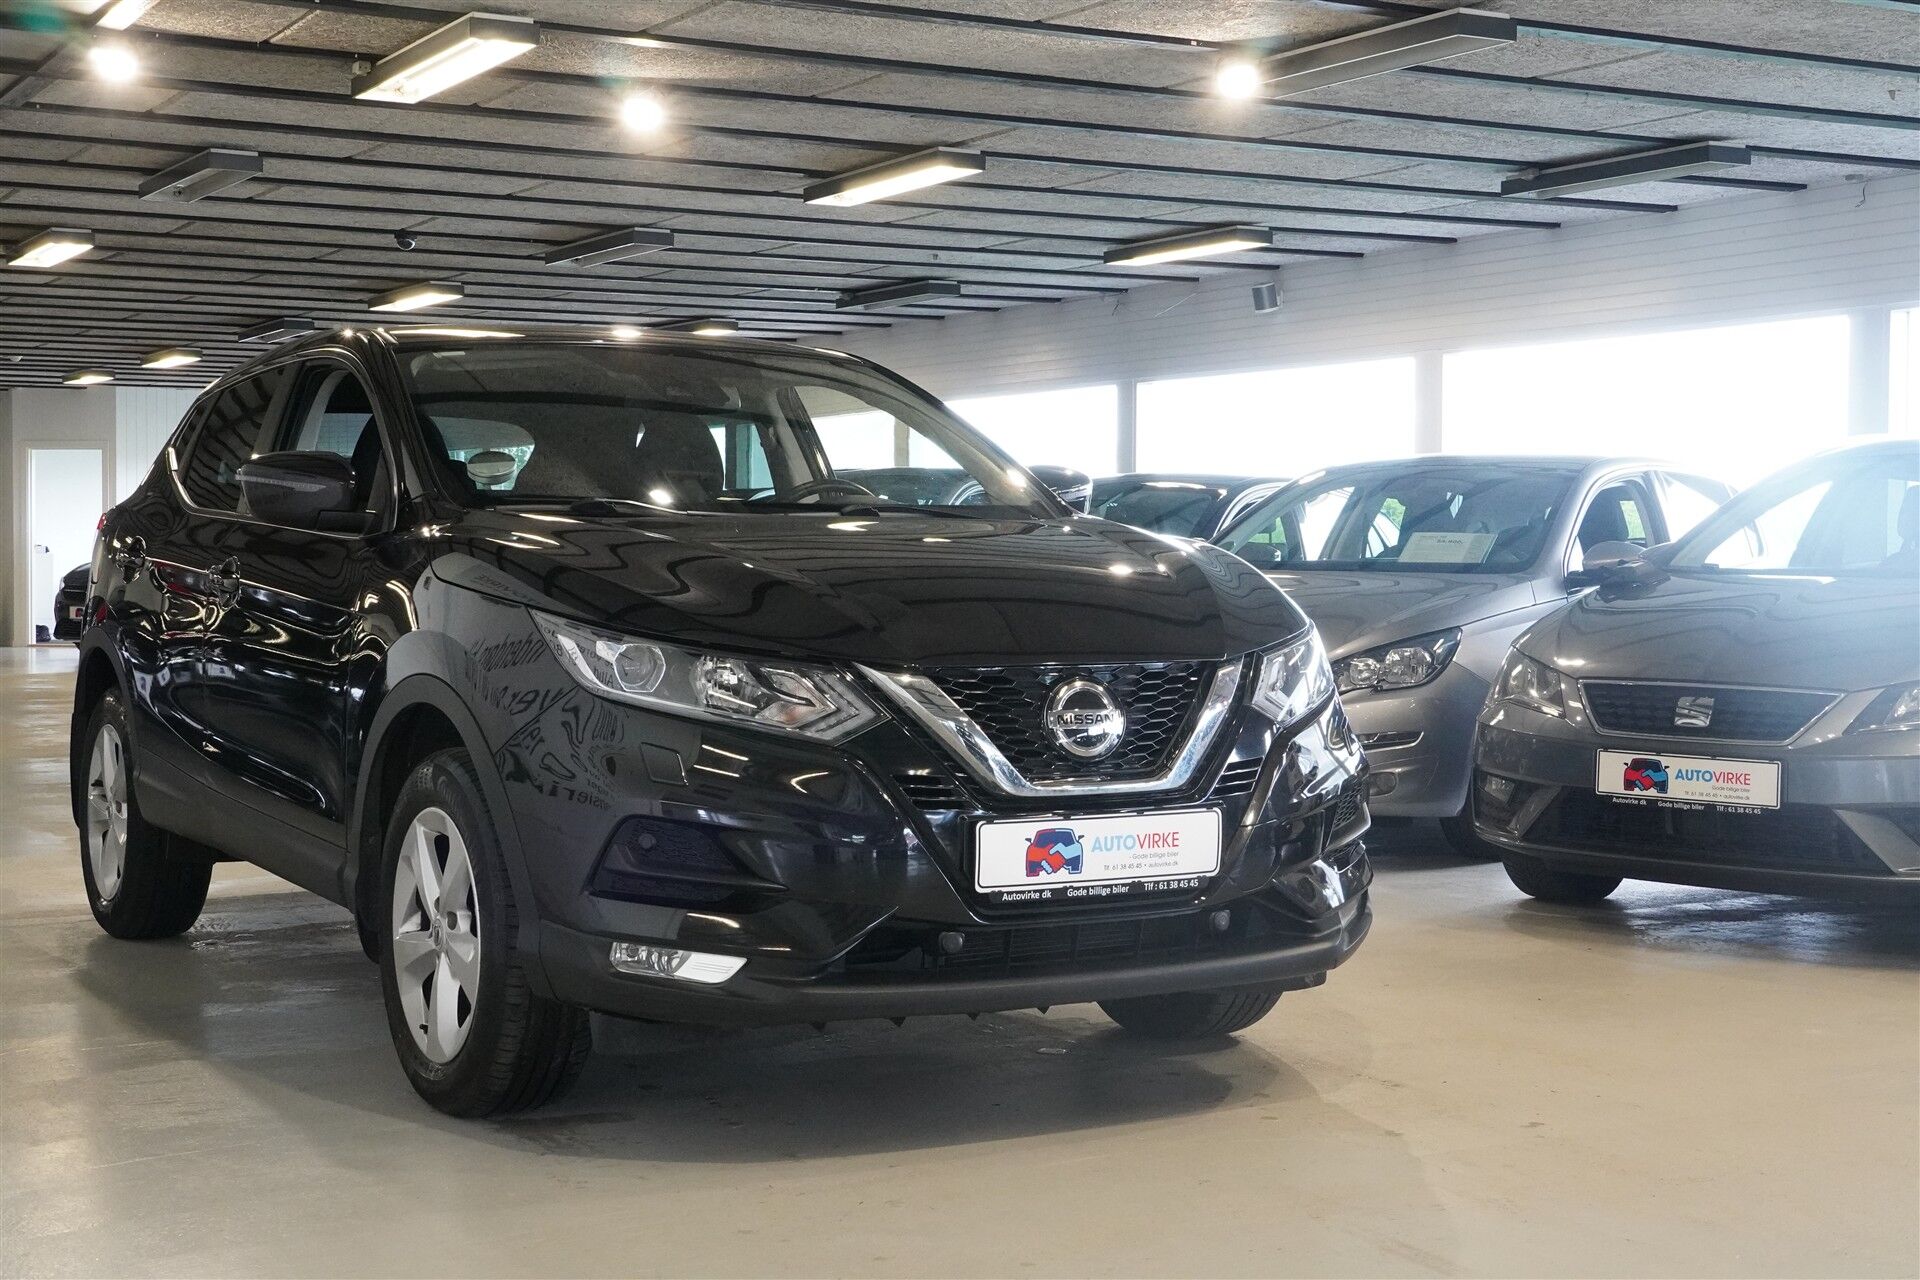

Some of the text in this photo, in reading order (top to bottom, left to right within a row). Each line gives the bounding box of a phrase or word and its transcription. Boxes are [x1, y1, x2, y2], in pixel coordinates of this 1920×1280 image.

[1057, 713, 1114, 725] NISSAN
[1675, 768, 1751, 786] AUTOVIRKE
[1612, 797, 1638, 805] Autovirke
[1673, 802, 1690, 810] billige
[1091, 832, 1179, 853] AUTOVIRKE
[1159, 881, 1168, 890] 61
[1169, 880, 1178, 889] 38
[1179, 879, 1188, 888] 45
[1189, 879, 1199, 887] 45
[1002, 891, 1039, 901] Autovirke
[1067, 885, 1129, 897] Gode billige biler
